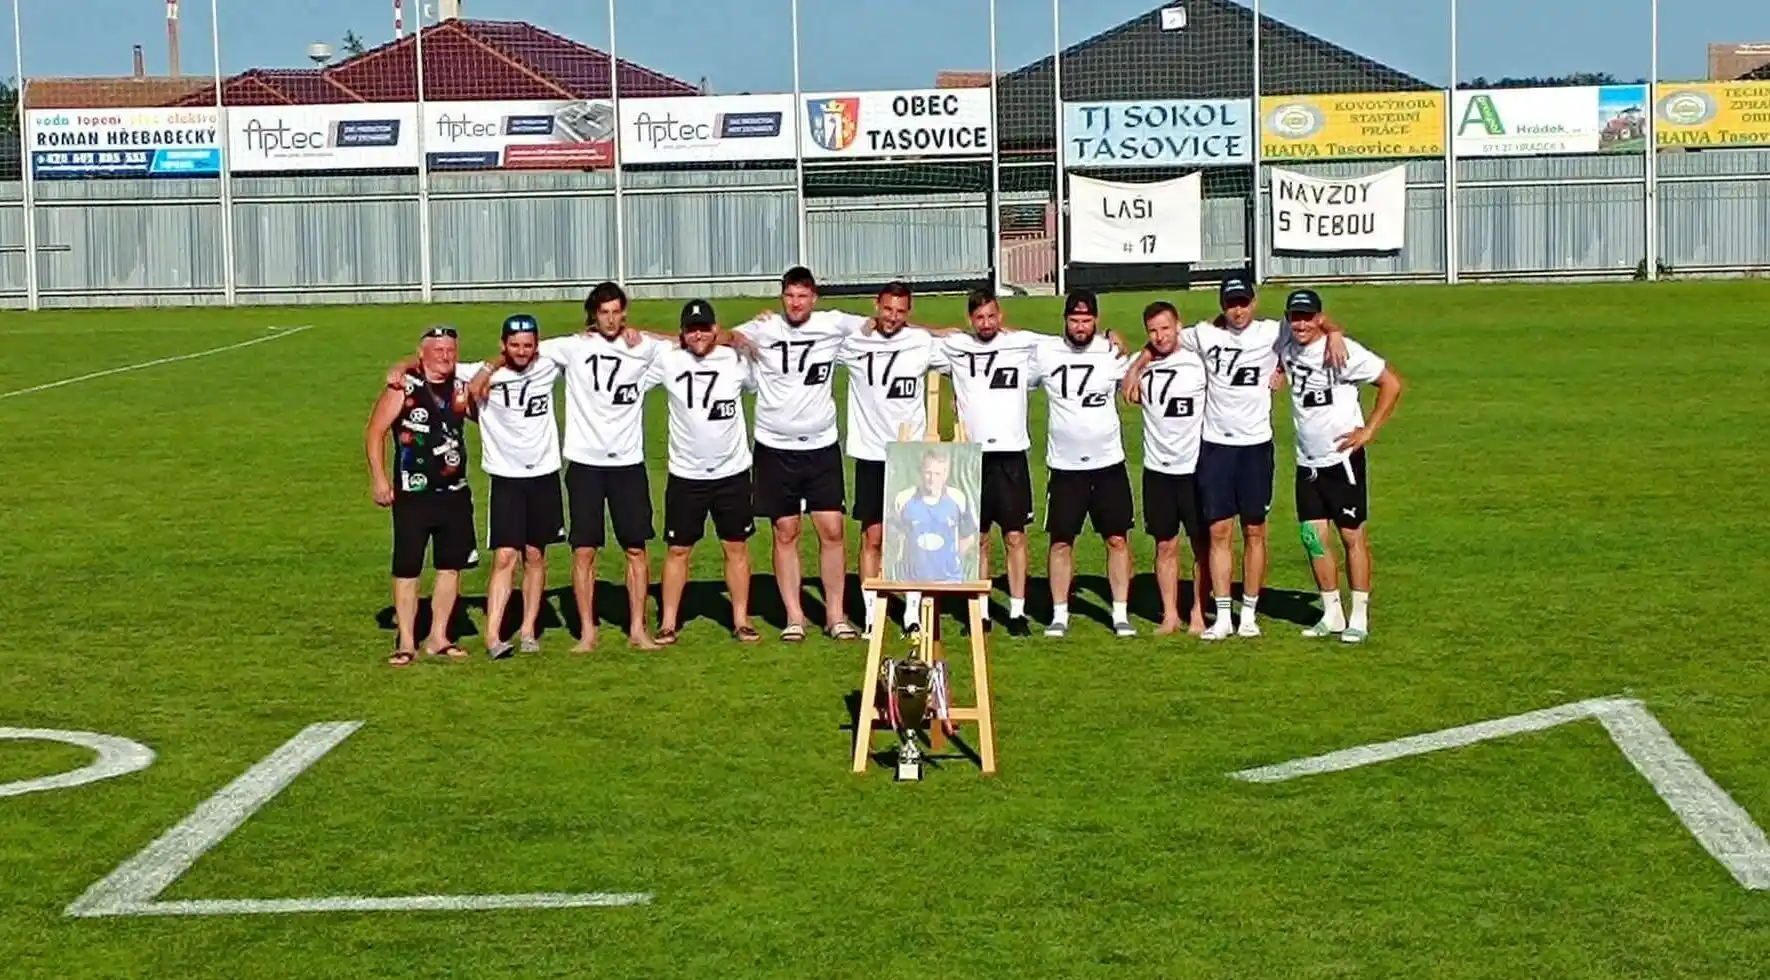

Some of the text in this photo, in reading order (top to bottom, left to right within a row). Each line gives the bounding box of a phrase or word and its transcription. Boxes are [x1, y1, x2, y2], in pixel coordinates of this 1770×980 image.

[893, 95, 959, 117] OBEC
[1079, 104, 1238, 135] TJ SOKOL
[37, 126, 217, 146] ROMAN HŘEBABECKÝ
[242, 118, 324, 159] Aptec
[436, 113, 496, 143] Aptec
[633, 112, 710, 149] Aptec
[867, 127, 988, 150] TASOVICE
[1072, 136, 1244, 160] TASOVICE
[1326, 140, 1403, 155] Tasovice
[1278, 211, 1374, 237] S TEBOU
[770, 340, 815, 374] 17
[857, 350, 900, 387] 17
[957, 350, 999, 378] 17
[585, 353, 623, 392] 17
[818, 365, 829, 382] 9
[1004, 370, 1015, 386] 7
[1050, 364, 1095, 399] 17
[1243, 370, 1255, 384] 2
[675, 370, 719, 409] 17
[895, 378, 914, 396] 10
[1141, 369, 1178, 406] 17
[716, 401, 736, 417] 16
